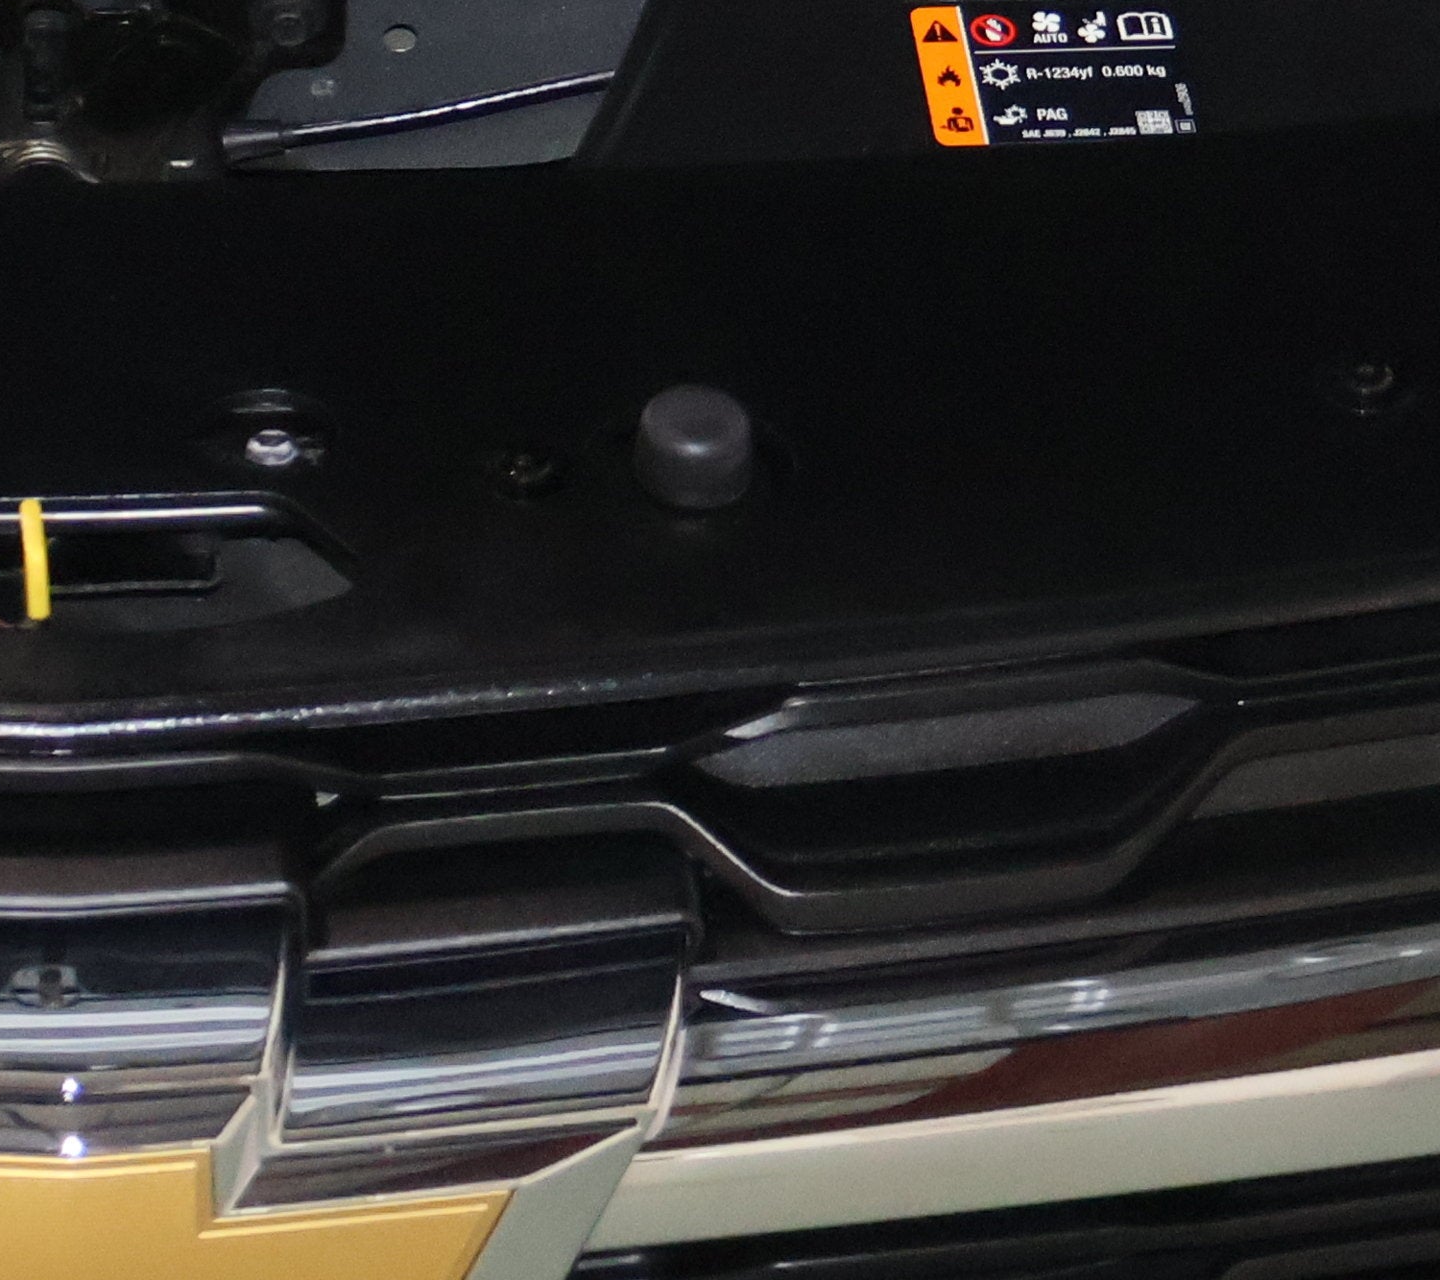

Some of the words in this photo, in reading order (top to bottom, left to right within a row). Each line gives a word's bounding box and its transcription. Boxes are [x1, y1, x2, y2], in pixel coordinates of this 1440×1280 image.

[1033, 33, 1068, 44] AUTO
[1026, 66, 1093, 80] R-1234yf
[1146, 64, 1166, 78] kg
[1036, 108, 1068, 121] PAG
